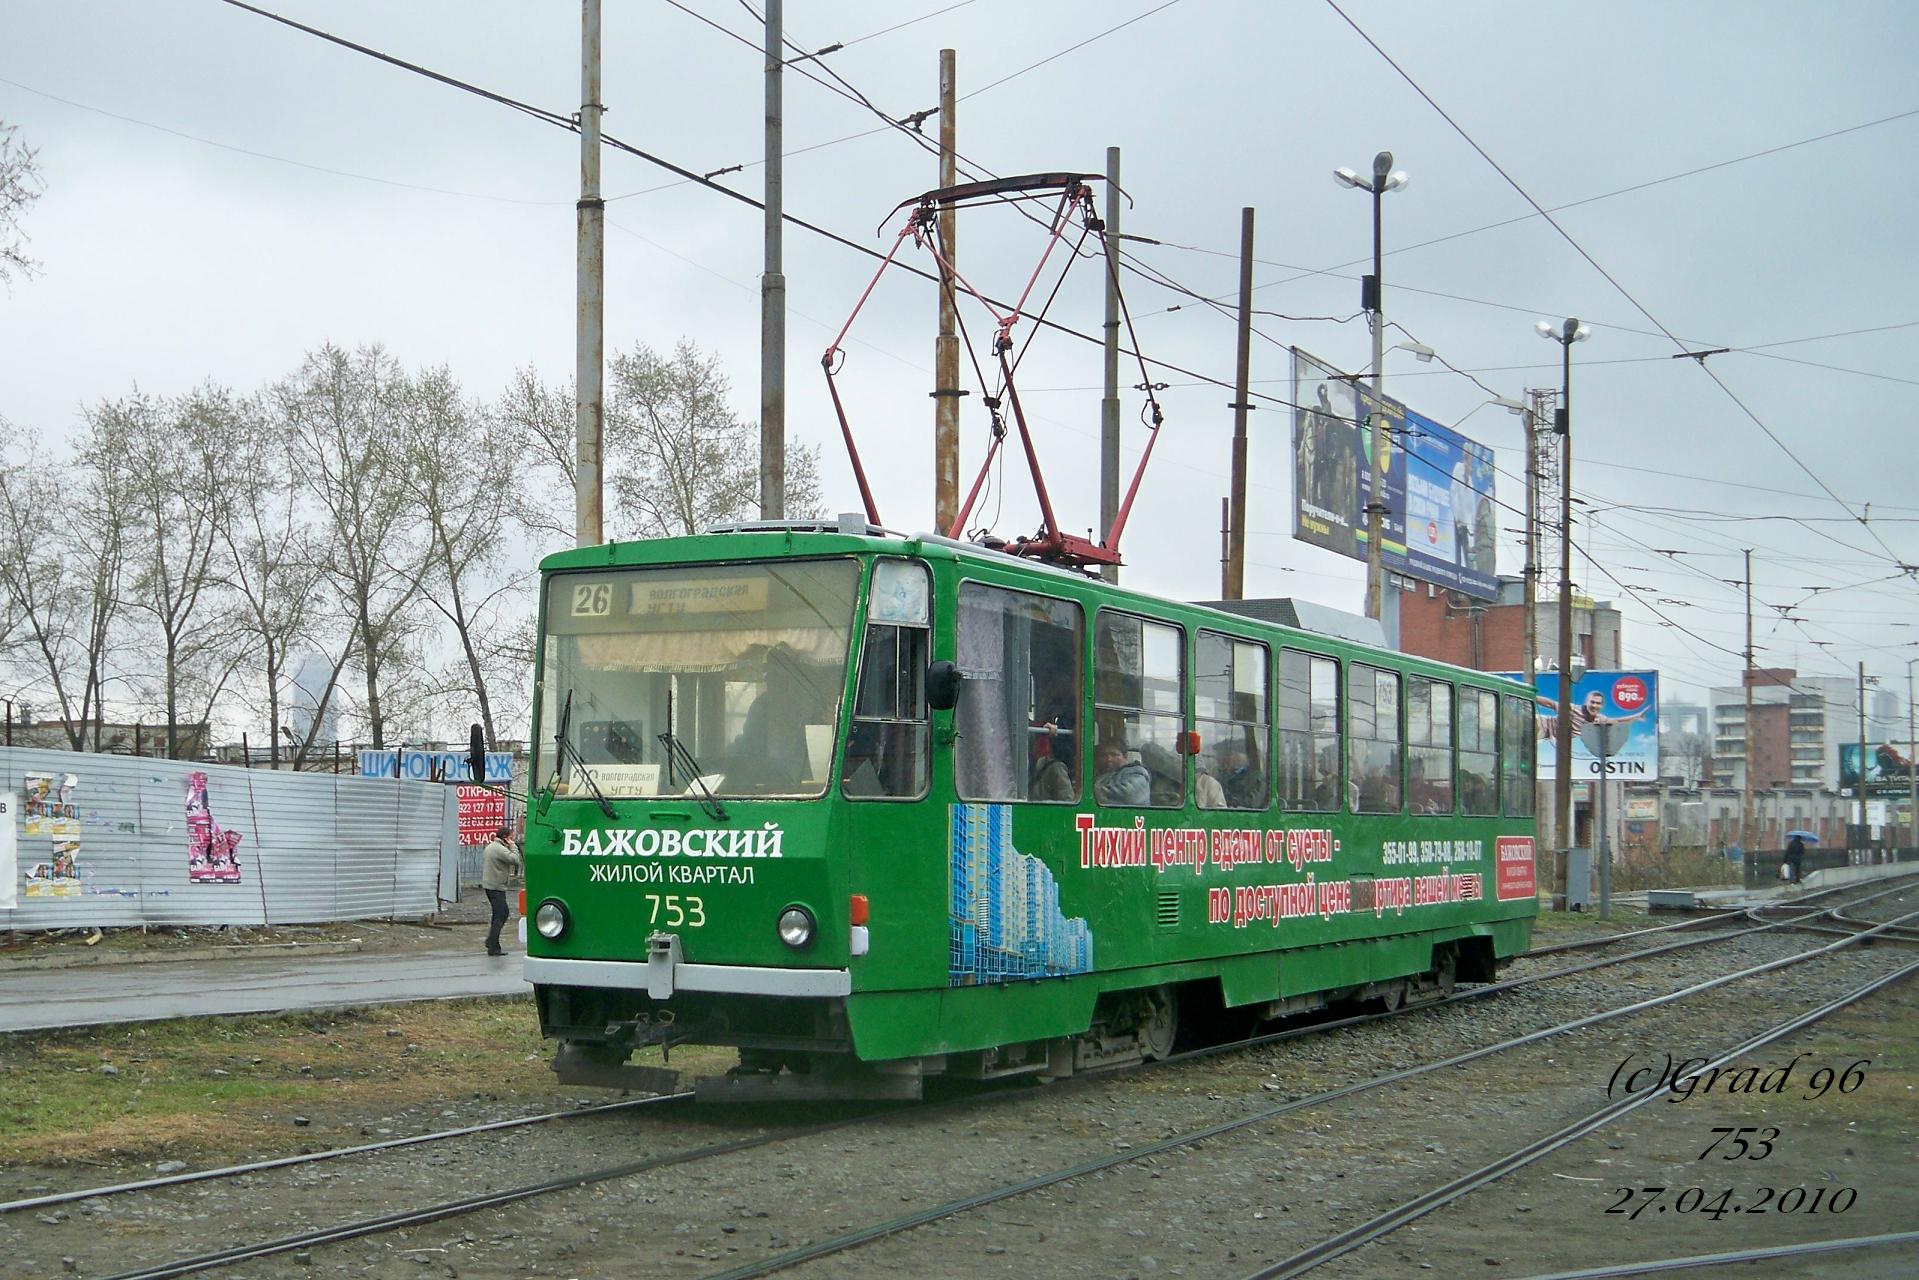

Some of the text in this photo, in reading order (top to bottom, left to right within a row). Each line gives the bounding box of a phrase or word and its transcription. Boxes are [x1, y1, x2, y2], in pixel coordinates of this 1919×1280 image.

[575, 585, 610, 614] 26
[1618, 691, 1638, 702] 890
[361, 752, 513, 779] ШИНОМОНАЖ
[459, 833, 471, 845] 24
[561, 822, 785, 858] БАЖОВСКИЙ
[1076, 814, 1146, 868] Тихий
[1150, 828, 1206, 874] центр
[1211, 829, 1262, 871] вдали
[1266, 829, 1284, 863] от
[1287, 829, 1332, 871] суеты
[589, 862, 755, 884] ЖИЛОЙ КВАРТАЛ
[645, 895, 706, 927] 753
[1208, 887, 1230, 923] по
[1234, 872, 1315, 928] доступной
[1319, 880, 1350, 921] цене
[1414, 866, 1449, 906] вашей
